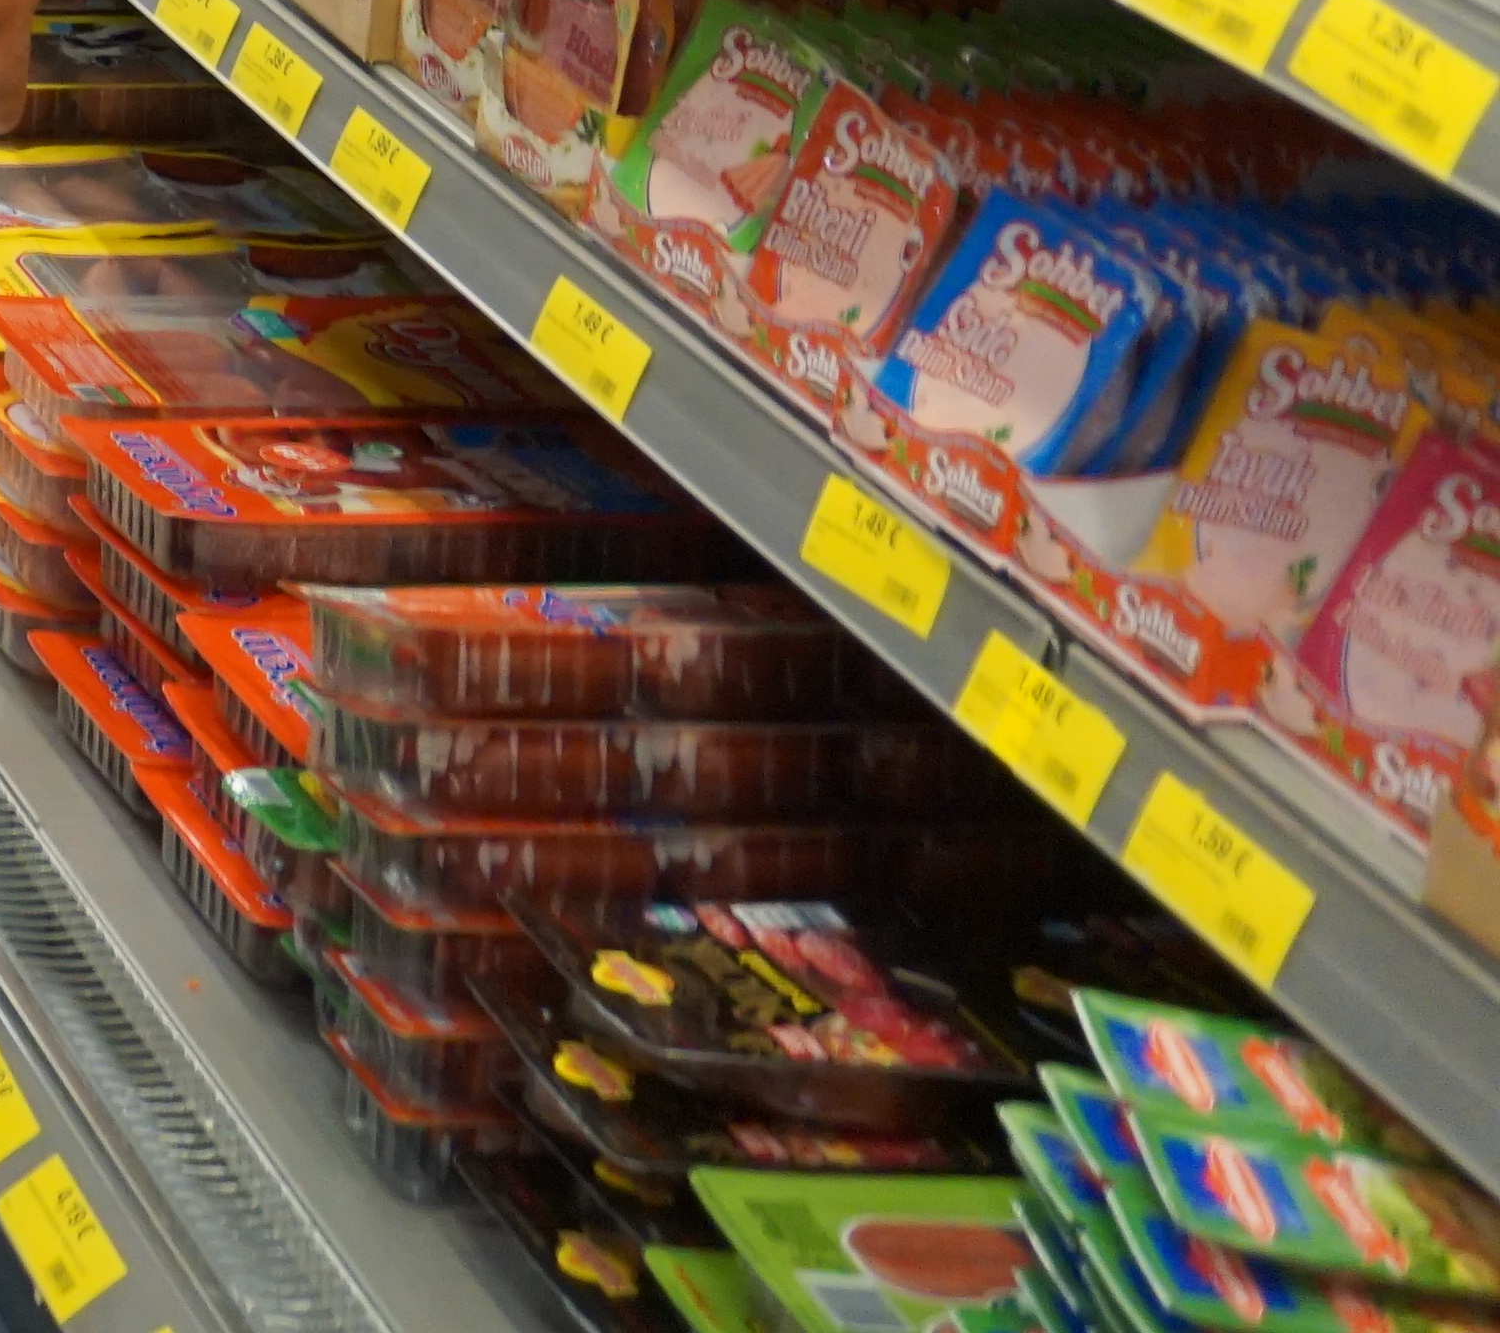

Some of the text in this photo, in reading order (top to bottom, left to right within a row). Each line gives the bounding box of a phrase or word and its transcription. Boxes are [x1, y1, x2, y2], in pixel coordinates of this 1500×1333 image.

[823, 110, 936, 201] Sohbet
[981, 219, 1126, 327] Sohbet
[1246, 344, 1411, 432] Sohbet
